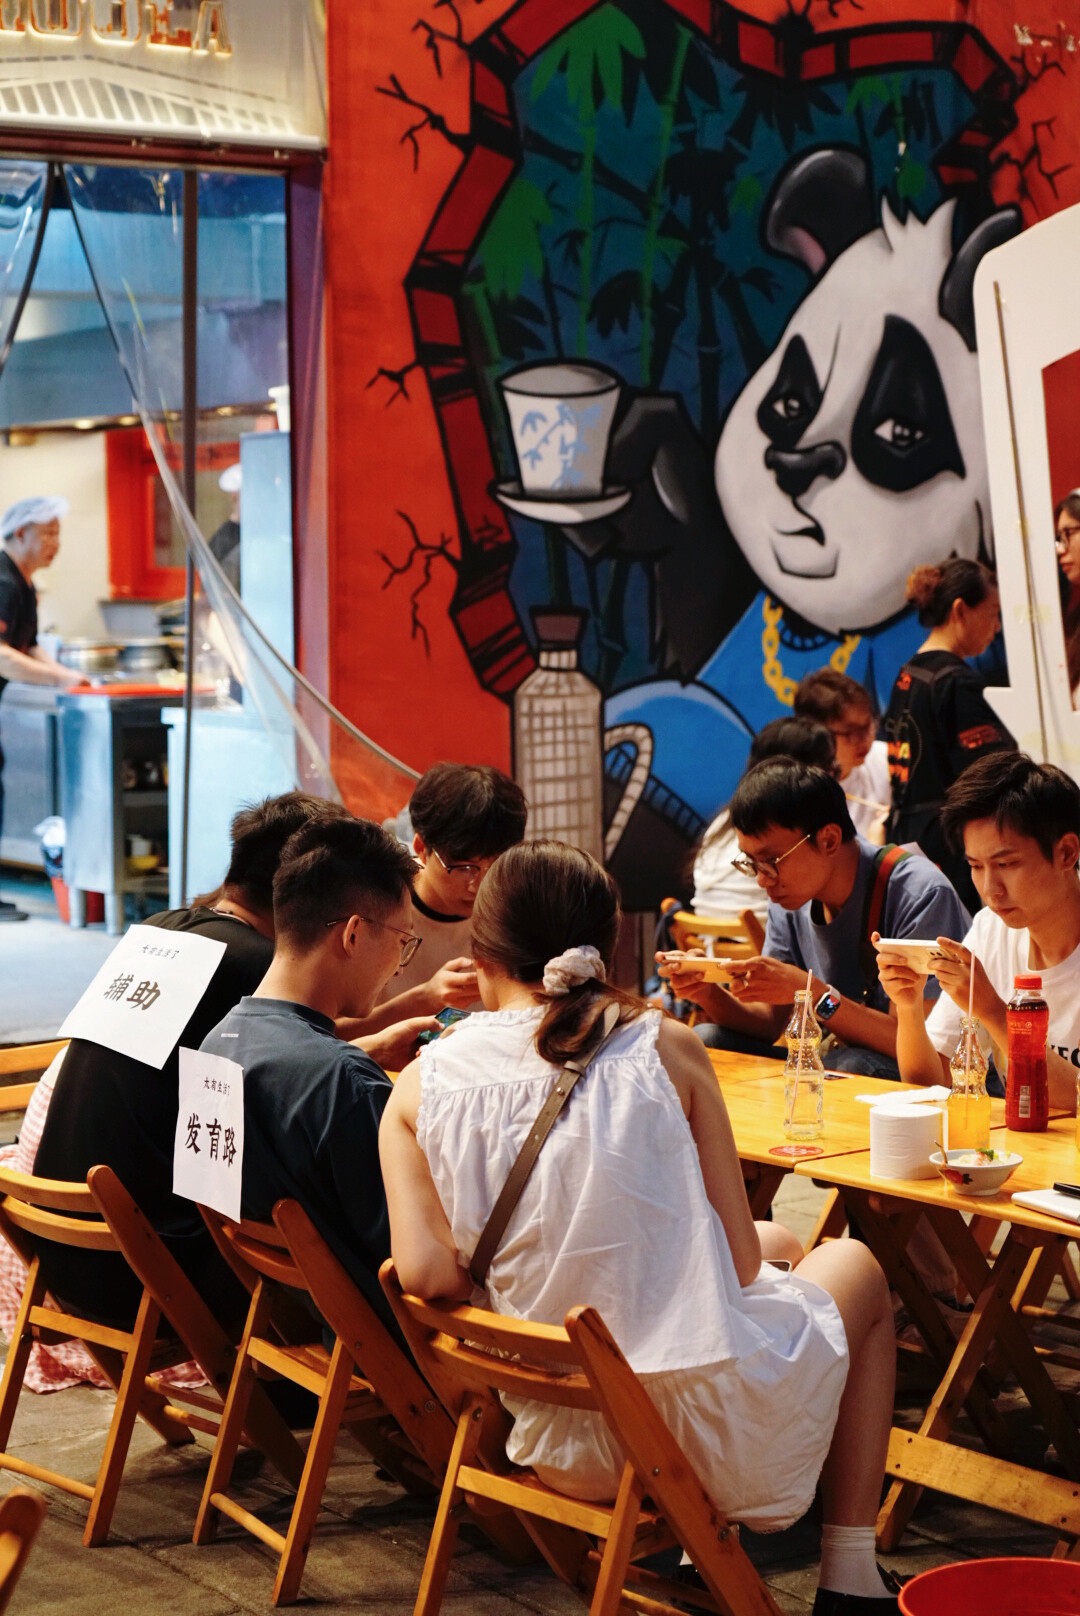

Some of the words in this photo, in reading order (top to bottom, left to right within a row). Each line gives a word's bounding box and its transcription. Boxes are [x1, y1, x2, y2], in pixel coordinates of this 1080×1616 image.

[104, 972, 161, 1010] 辅助
[185, 1112, 237, 1168] 发育路
